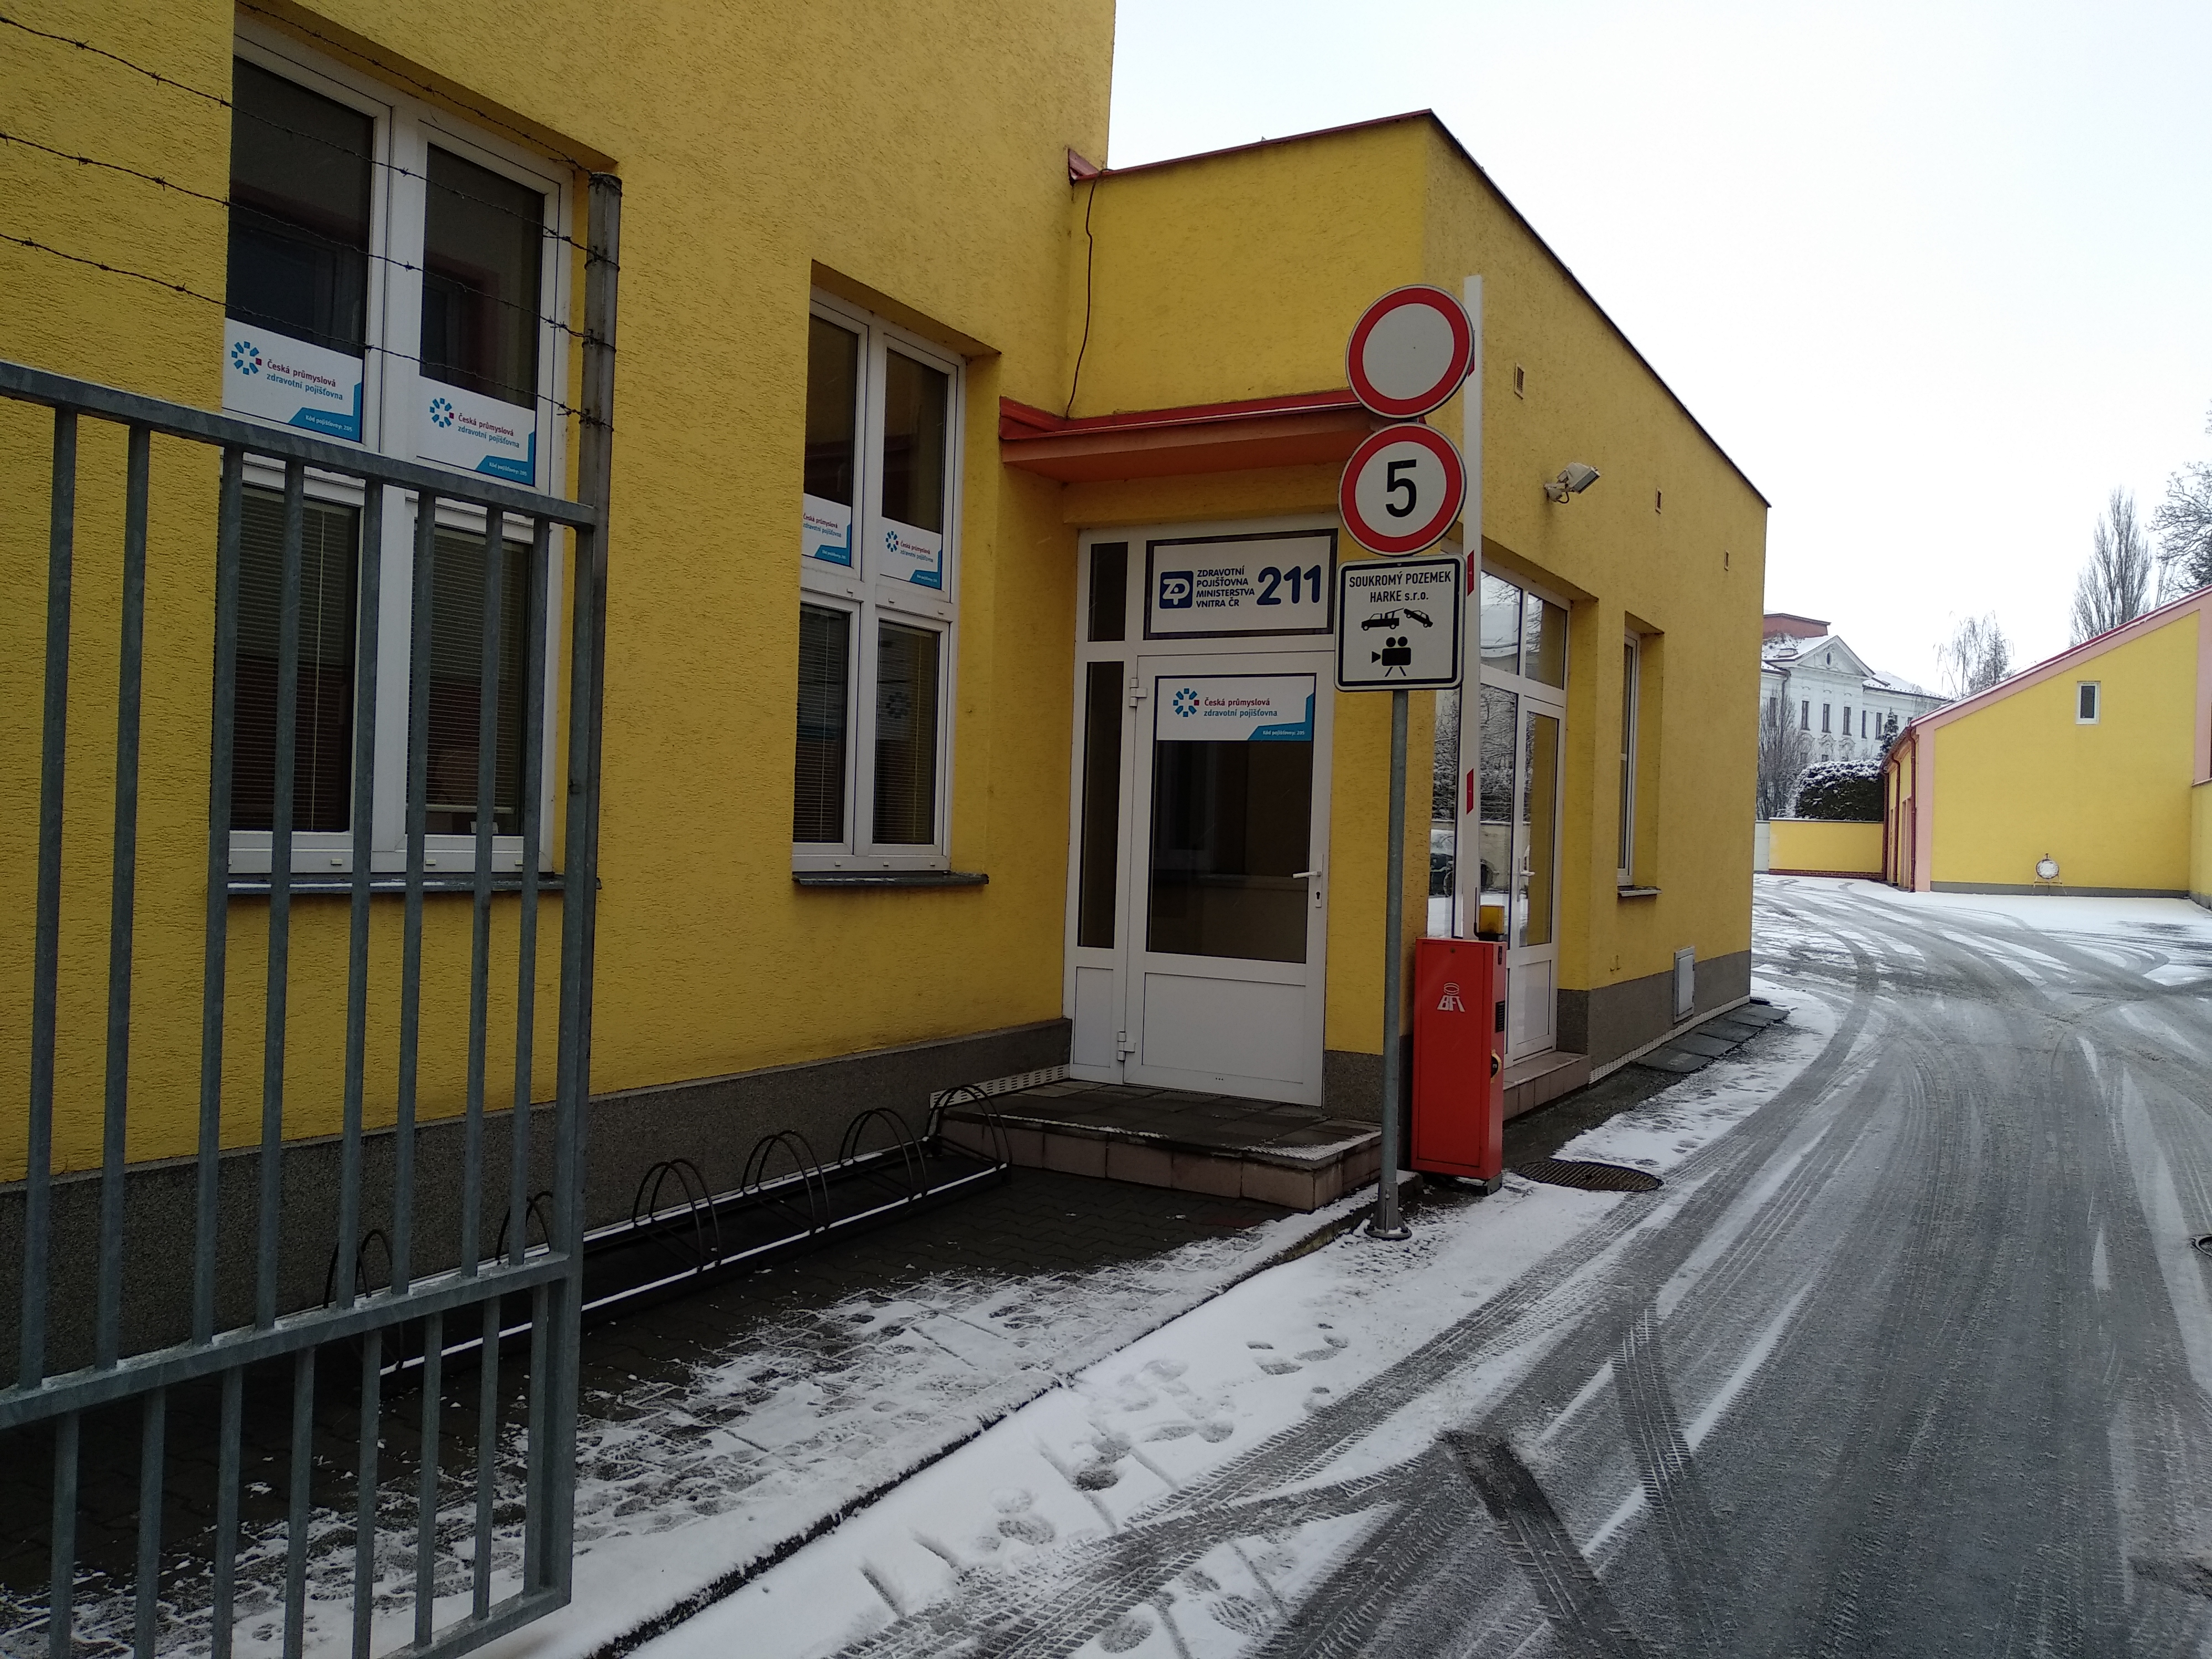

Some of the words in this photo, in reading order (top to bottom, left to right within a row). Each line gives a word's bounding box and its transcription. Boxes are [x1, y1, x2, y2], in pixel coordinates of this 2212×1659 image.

[267, 359, 290, 374] Česká
[293, 369, 336, 388] průmyslová
[267, 373, 303, 389] zdravotní
[305, 384, 343, 400] pojišťovna
[458, 413, 477, 426] Česká
[479, 421, 514, 436] průmyslová
[458, 425, 487, 439] zdravotní
[489, 434, 520, 448] pojišťovna
[1385, 459, 1417, 518] 5
[1197, 565, 1245, 577] ZDRAVOTNÍ
[1349, 571, 1403, 587] SOUKROMÝ
[1406, 571, 1452, 585] POZEMEK
[1196, 577, 1249, 588] POJIŠŤOVNA
[1256, 565, 1321, 606] 211
[1196, 588, 1255, 598] MINISTERSTVA
[1370, 590, 1402, 603] HARKE
[1404, 592, 1429, 601] s.r.o.
[1196, 599, 1226, 608] VNITRA
[1228, 597, 1239, 607] ČR
[1204, 697, 1225, 706] Česká
[1228, 698, 1270, 707] průmyslová
[1239, 708, 1277, 718] pojišťovna
[1437, 995, 1465, 1013] BFT
